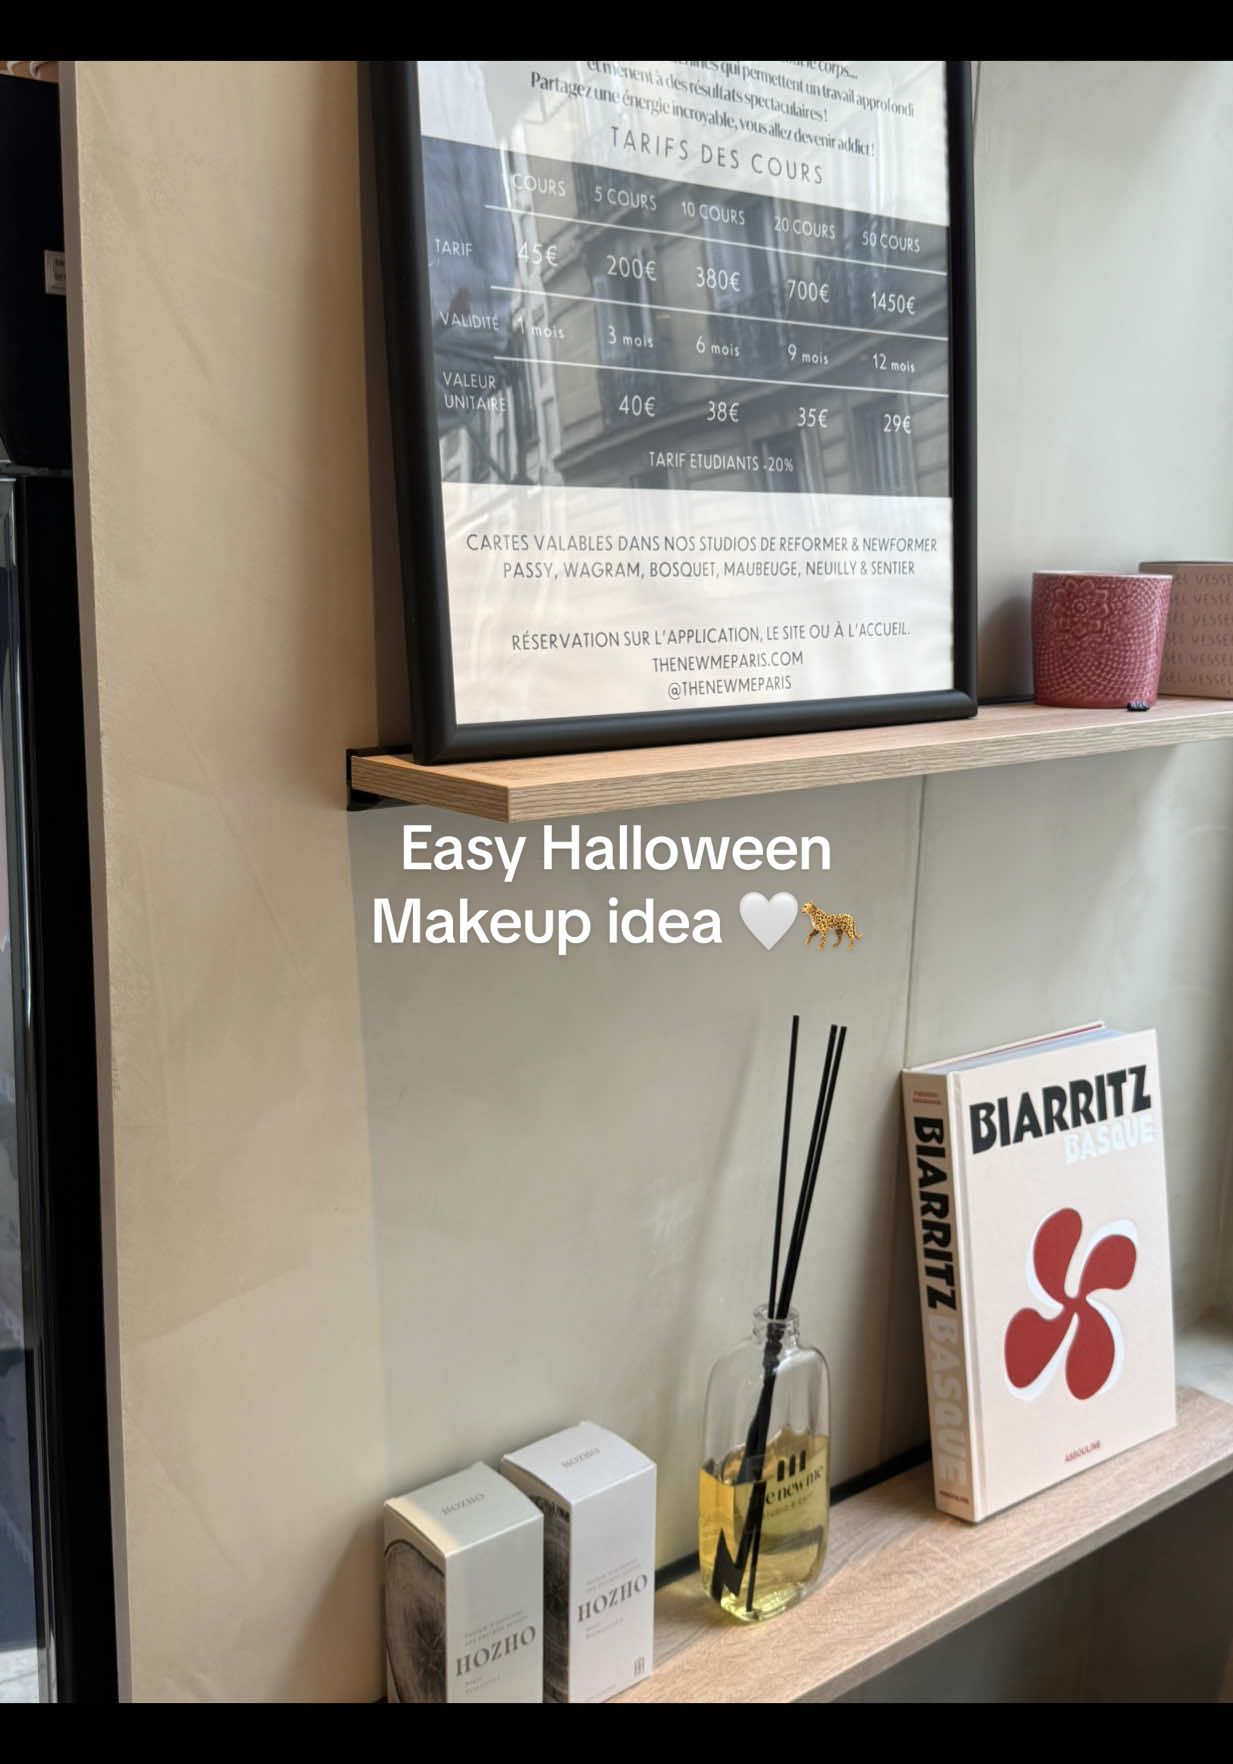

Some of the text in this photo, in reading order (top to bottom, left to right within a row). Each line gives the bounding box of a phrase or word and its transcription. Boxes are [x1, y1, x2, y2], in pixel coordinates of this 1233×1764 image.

[531, 71, 593, 99] Partagez
[594, 86, 619, 104] une
[622, 88, 670, 117] énergie
[672, 98, 738, 131] incroyable,
[739, 117, 768, 136] vous
[768, 121, 792, 141] allez
[793, 127, 836, 150] devenir
[666, 73, 688, 91] des
[689, 79, 743, 103] résultats
[720, 61, 741, 78] qui
[742, 65, 803, 94] permettent
[806, 82, 821, 97] un
[822, 82, 855, 104] travail
[856, 95, 914, 118] approfondi
[611, 126, 823, 185] TARIFS DES COURS
[511, 173, 920, 253] COURS 5 COURS 10 COURS 20 COURS 50 COURS
[434, 238, 916, 315] TARIF 45€ 200€ 380€ 700€ 1450€
[517, 315, 525, 335] 1
[530, 324, 566, 340] mois
[607, 326, 617, 345] 3
[622, 334, 654, 349] mois
[696, 336, 706, 354] 6
[710, 343, 740, 357] mois
[787, 343, 797, 361] 9
[801, 350, 829, 365] mois
[872, 353, 888, 370] 12
[891, 360, 915, 373] mois
[443, 371, 497, 389] VALEUR
[444, 395, 912, 434] UNITAIRE 40€ 38€ 35€ 29€
[649, 451, 794, 473] TARIF ETUDIANTS -20%
[466, 534, 937, 552] CARTES VALABLES DANS NOS STUDIOS DE REFORMER & NEWFORMER
[503, 560, 915, 580] PASSY, WAGRAM, BOSQUET, MAUBEUGE, NEUILLY & SENTIER
[512, 621, 911, 651] RÉSERVATION SUR L'APPLICATION, LE SITE OU À L'ACCUEIL.
[652, 651, 804, 673] THENEWMEPARIS.COM
[668, 675, 792, 701] @THENEWMEPARIS
[969, 1064, 1151, 1155] BIARRITZ
[1063, 1114, 1156, 1165] BASQUE
[913, 1116, 957, 1311] BIARRITZ
[927, 1315, 968, 1484] BASQUE
[577, 1574, 648, 1622] HOZHO
[456, 1625, 536, 1677] HOZHO
